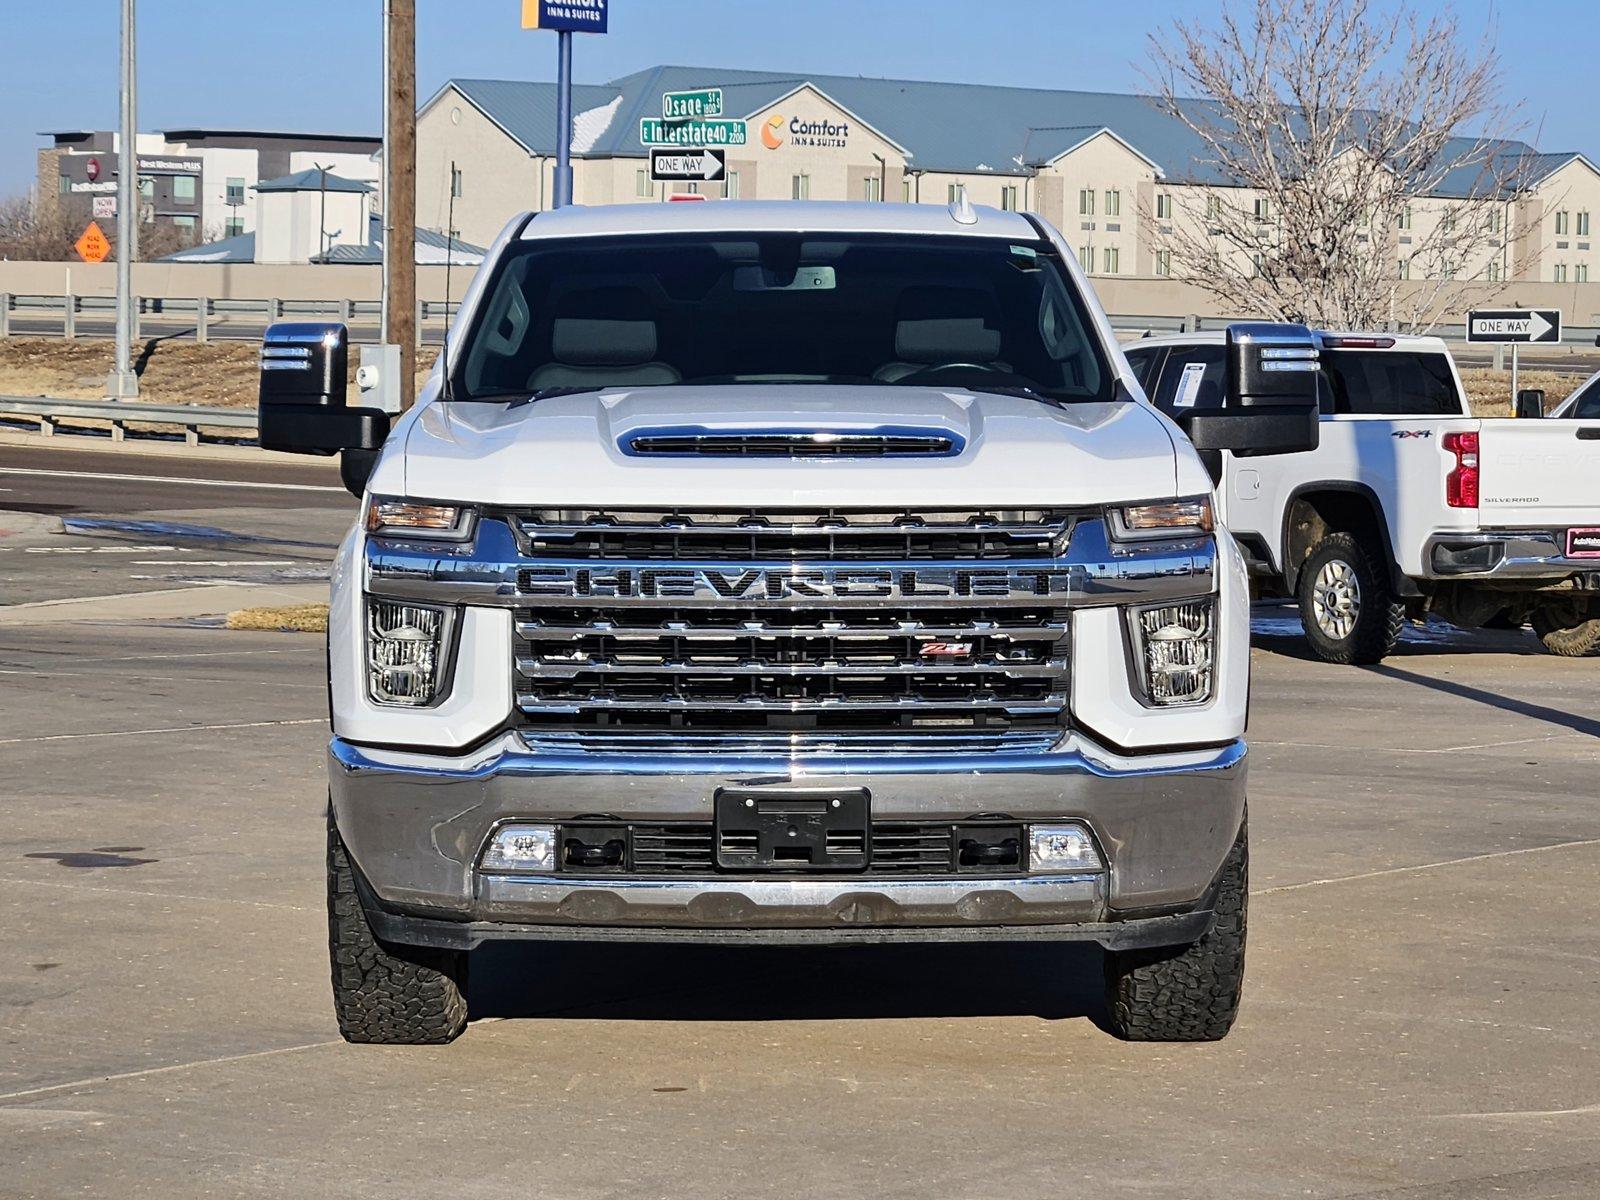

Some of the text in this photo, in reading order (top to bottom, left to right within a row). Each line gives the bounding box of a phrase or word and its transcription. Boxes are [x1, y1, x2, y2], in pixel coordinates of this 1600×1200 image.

[547, 6, 600, 21] INN & SUITES
[665, 95, 702, 117] Osage
[789, 116, 849, 137] Comfort
[728, 132, 745, 144] 2200
[791, 136, 808, 146] INN
[816, 138, 846, 148] SUITES
[658, 158, 703, 171] ONE WAY
[1480, 321, 1530, 332] ONE WAY
[515, 568, 1070, 598] CHEVROLET
